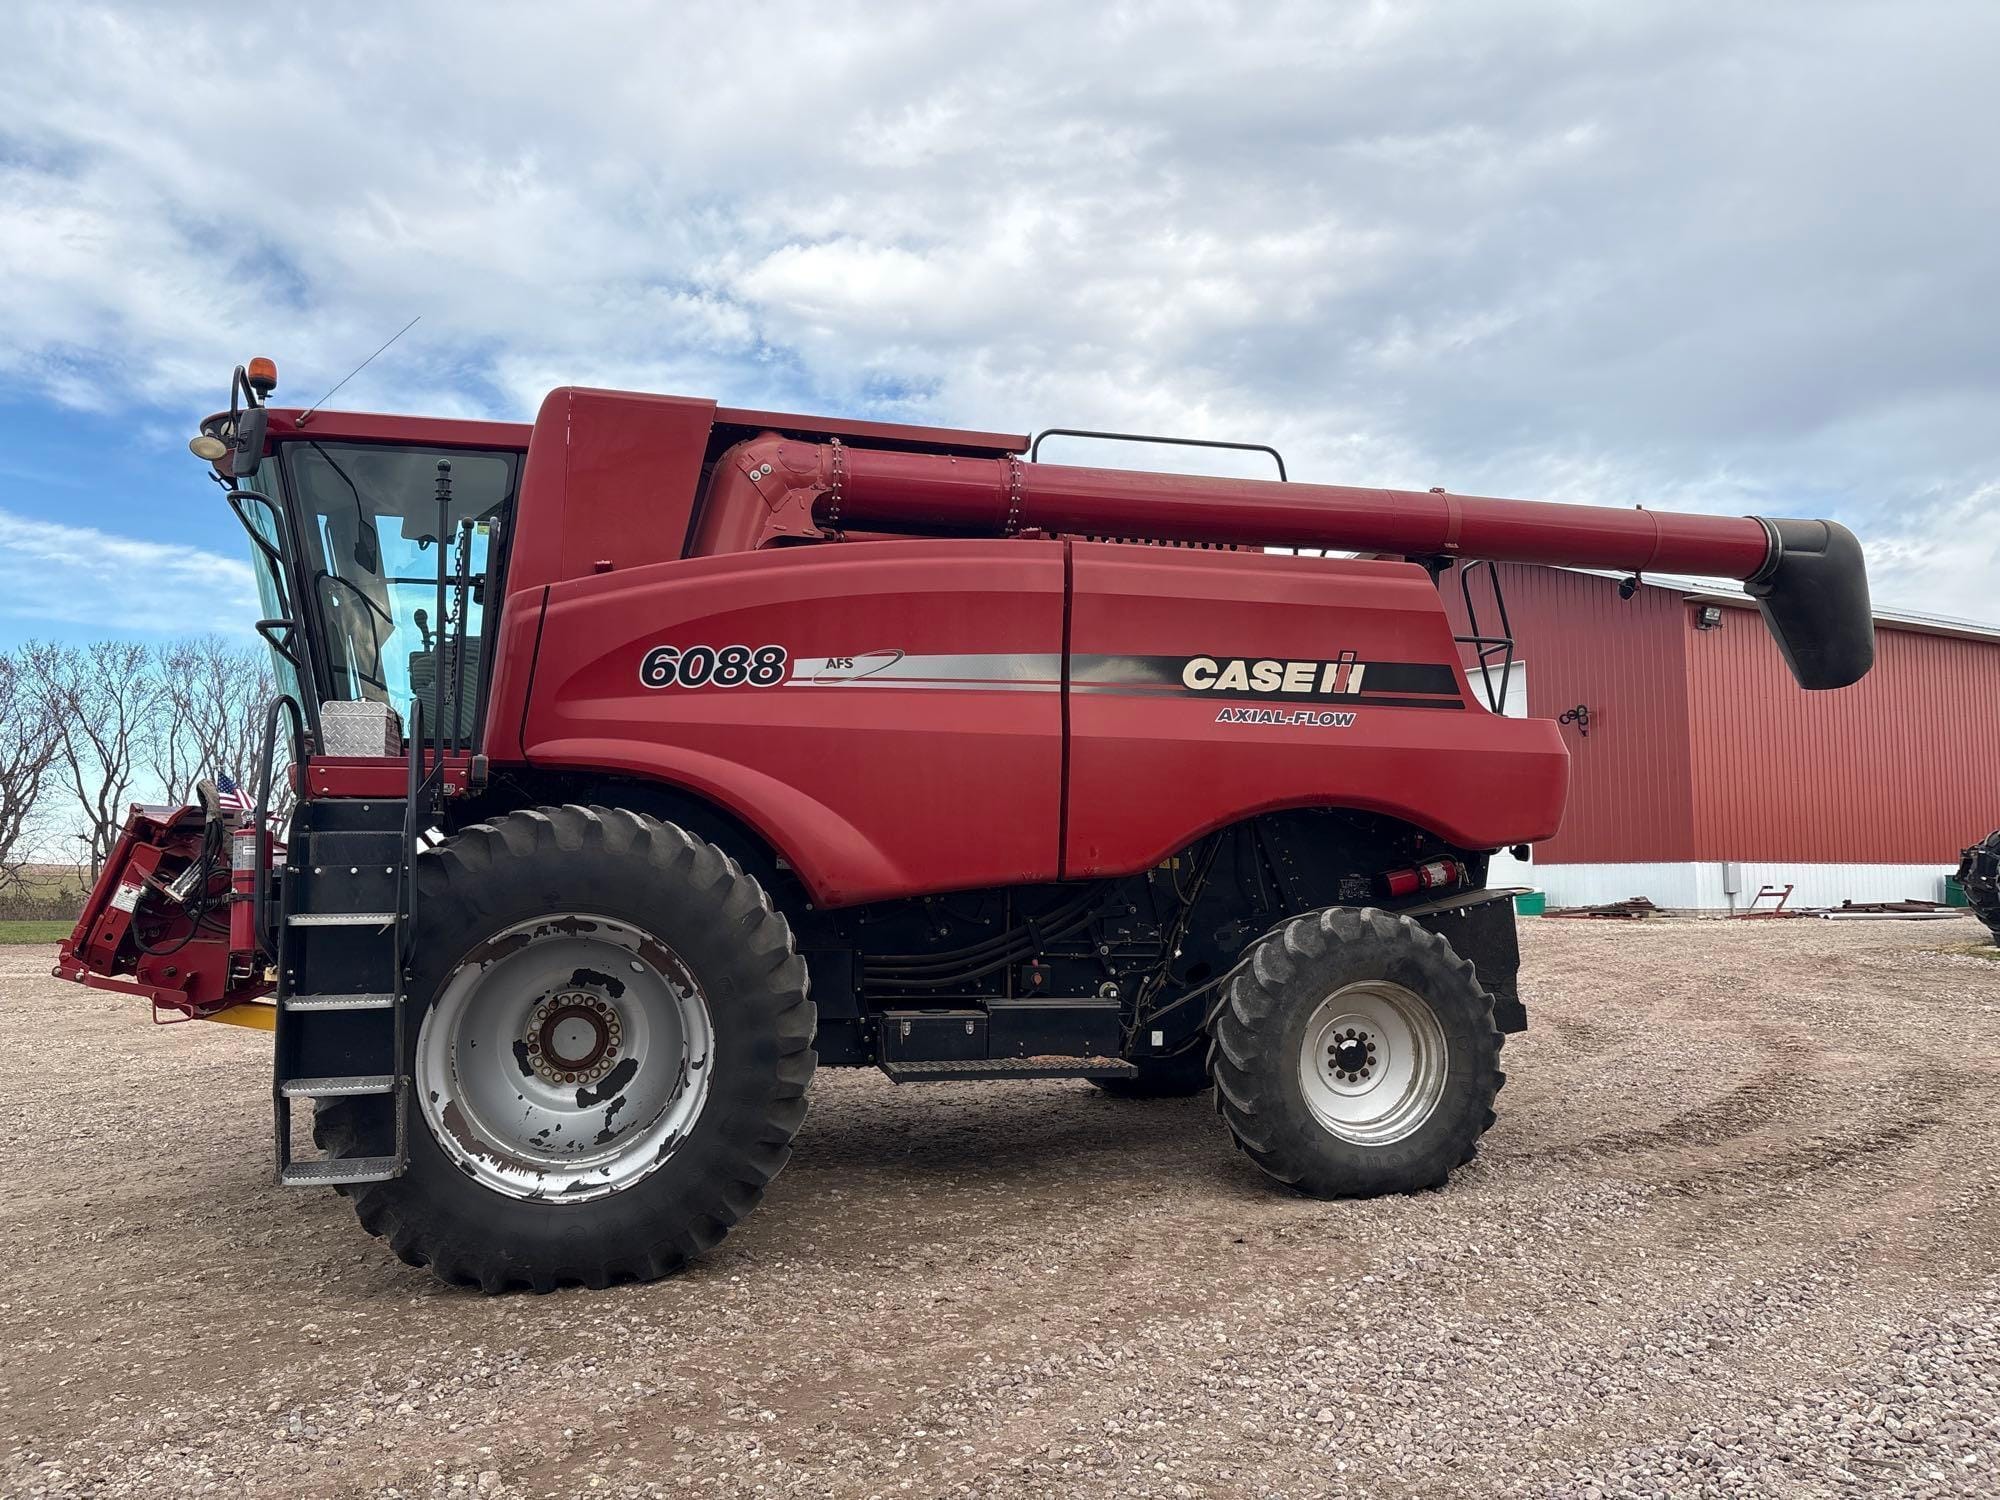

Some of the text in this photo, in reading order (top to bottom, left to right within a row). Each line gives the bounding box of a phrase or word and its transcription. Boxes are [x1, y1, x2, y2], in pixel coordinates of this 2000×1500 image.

[640, 645, 787, 689] 6088
[825, 657, 854, 670] AFS
[1182, 657, 1317, 692] CASE
[1215, 707, 1357, 727] AXIAL-FLOW
